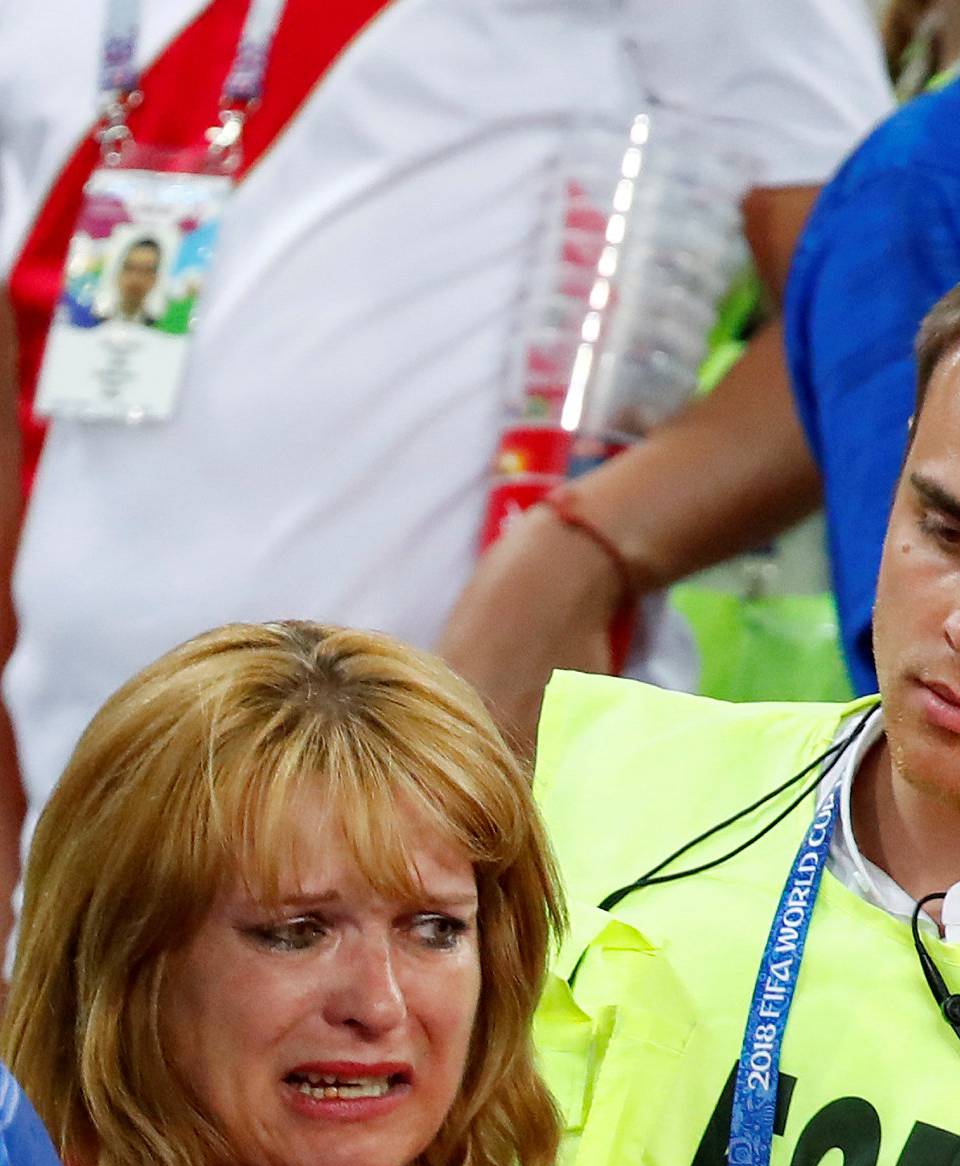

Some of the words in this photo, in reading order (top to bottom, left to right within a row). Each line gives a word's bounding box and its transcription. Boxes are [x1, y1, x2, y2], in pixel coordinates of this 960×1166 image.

[775, 851, 819, 955] WORLD
[759, 957, 794, 1020] FIFA
[747, 1022, 777, 1092] 2018
